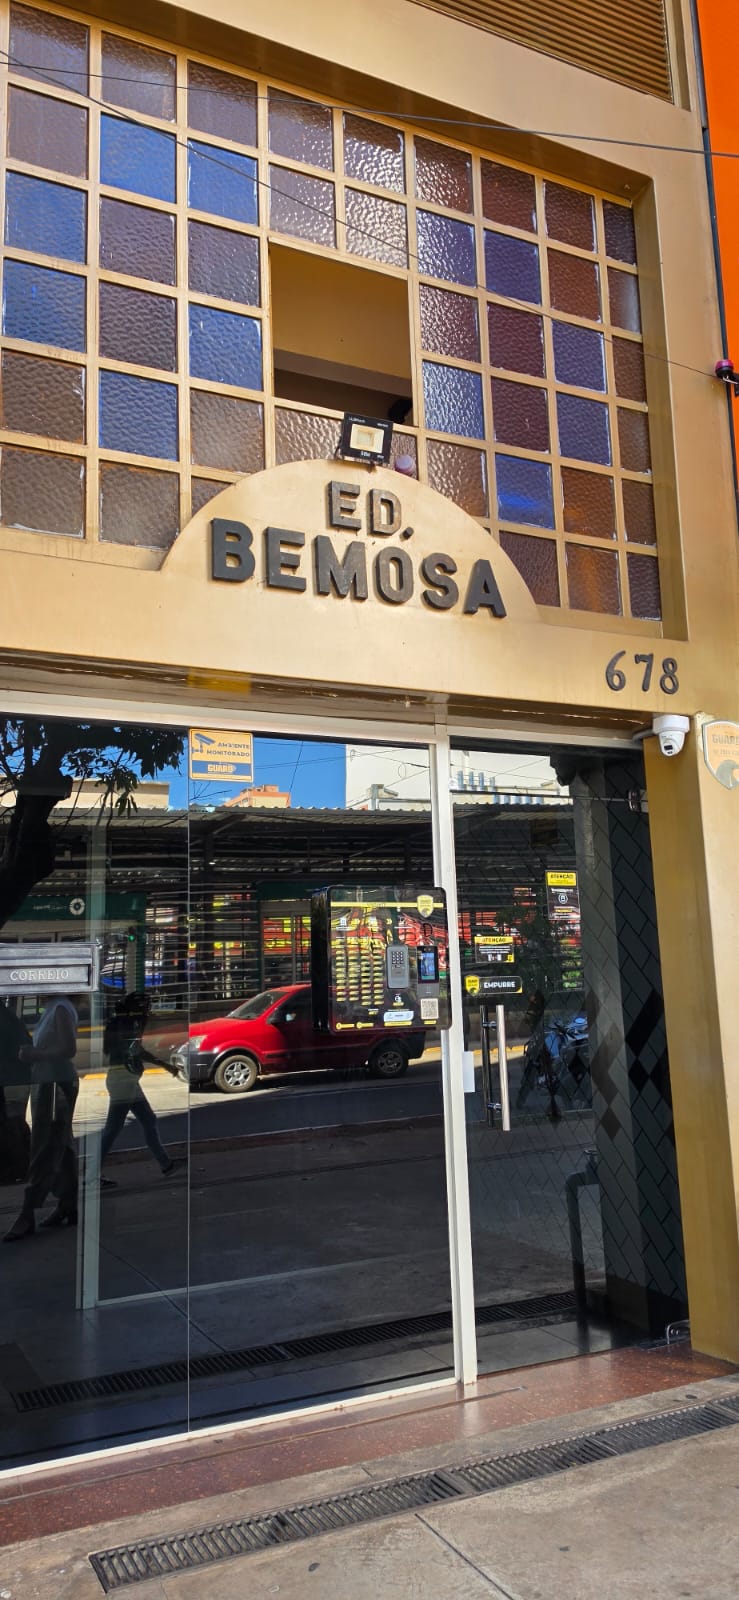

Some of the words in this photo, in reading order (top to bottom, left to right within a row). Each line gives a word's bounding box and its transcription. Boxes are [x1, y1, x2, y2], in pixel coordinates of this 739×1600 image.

[210, 517, 507, 618] BEMOSA
[605, 651, 679, 695] 678
[206, 749, 250, 757] MONITORADO
[9, 969, 69, 981] CORREIO
[483, 980, 516, 989] EMPURRE
